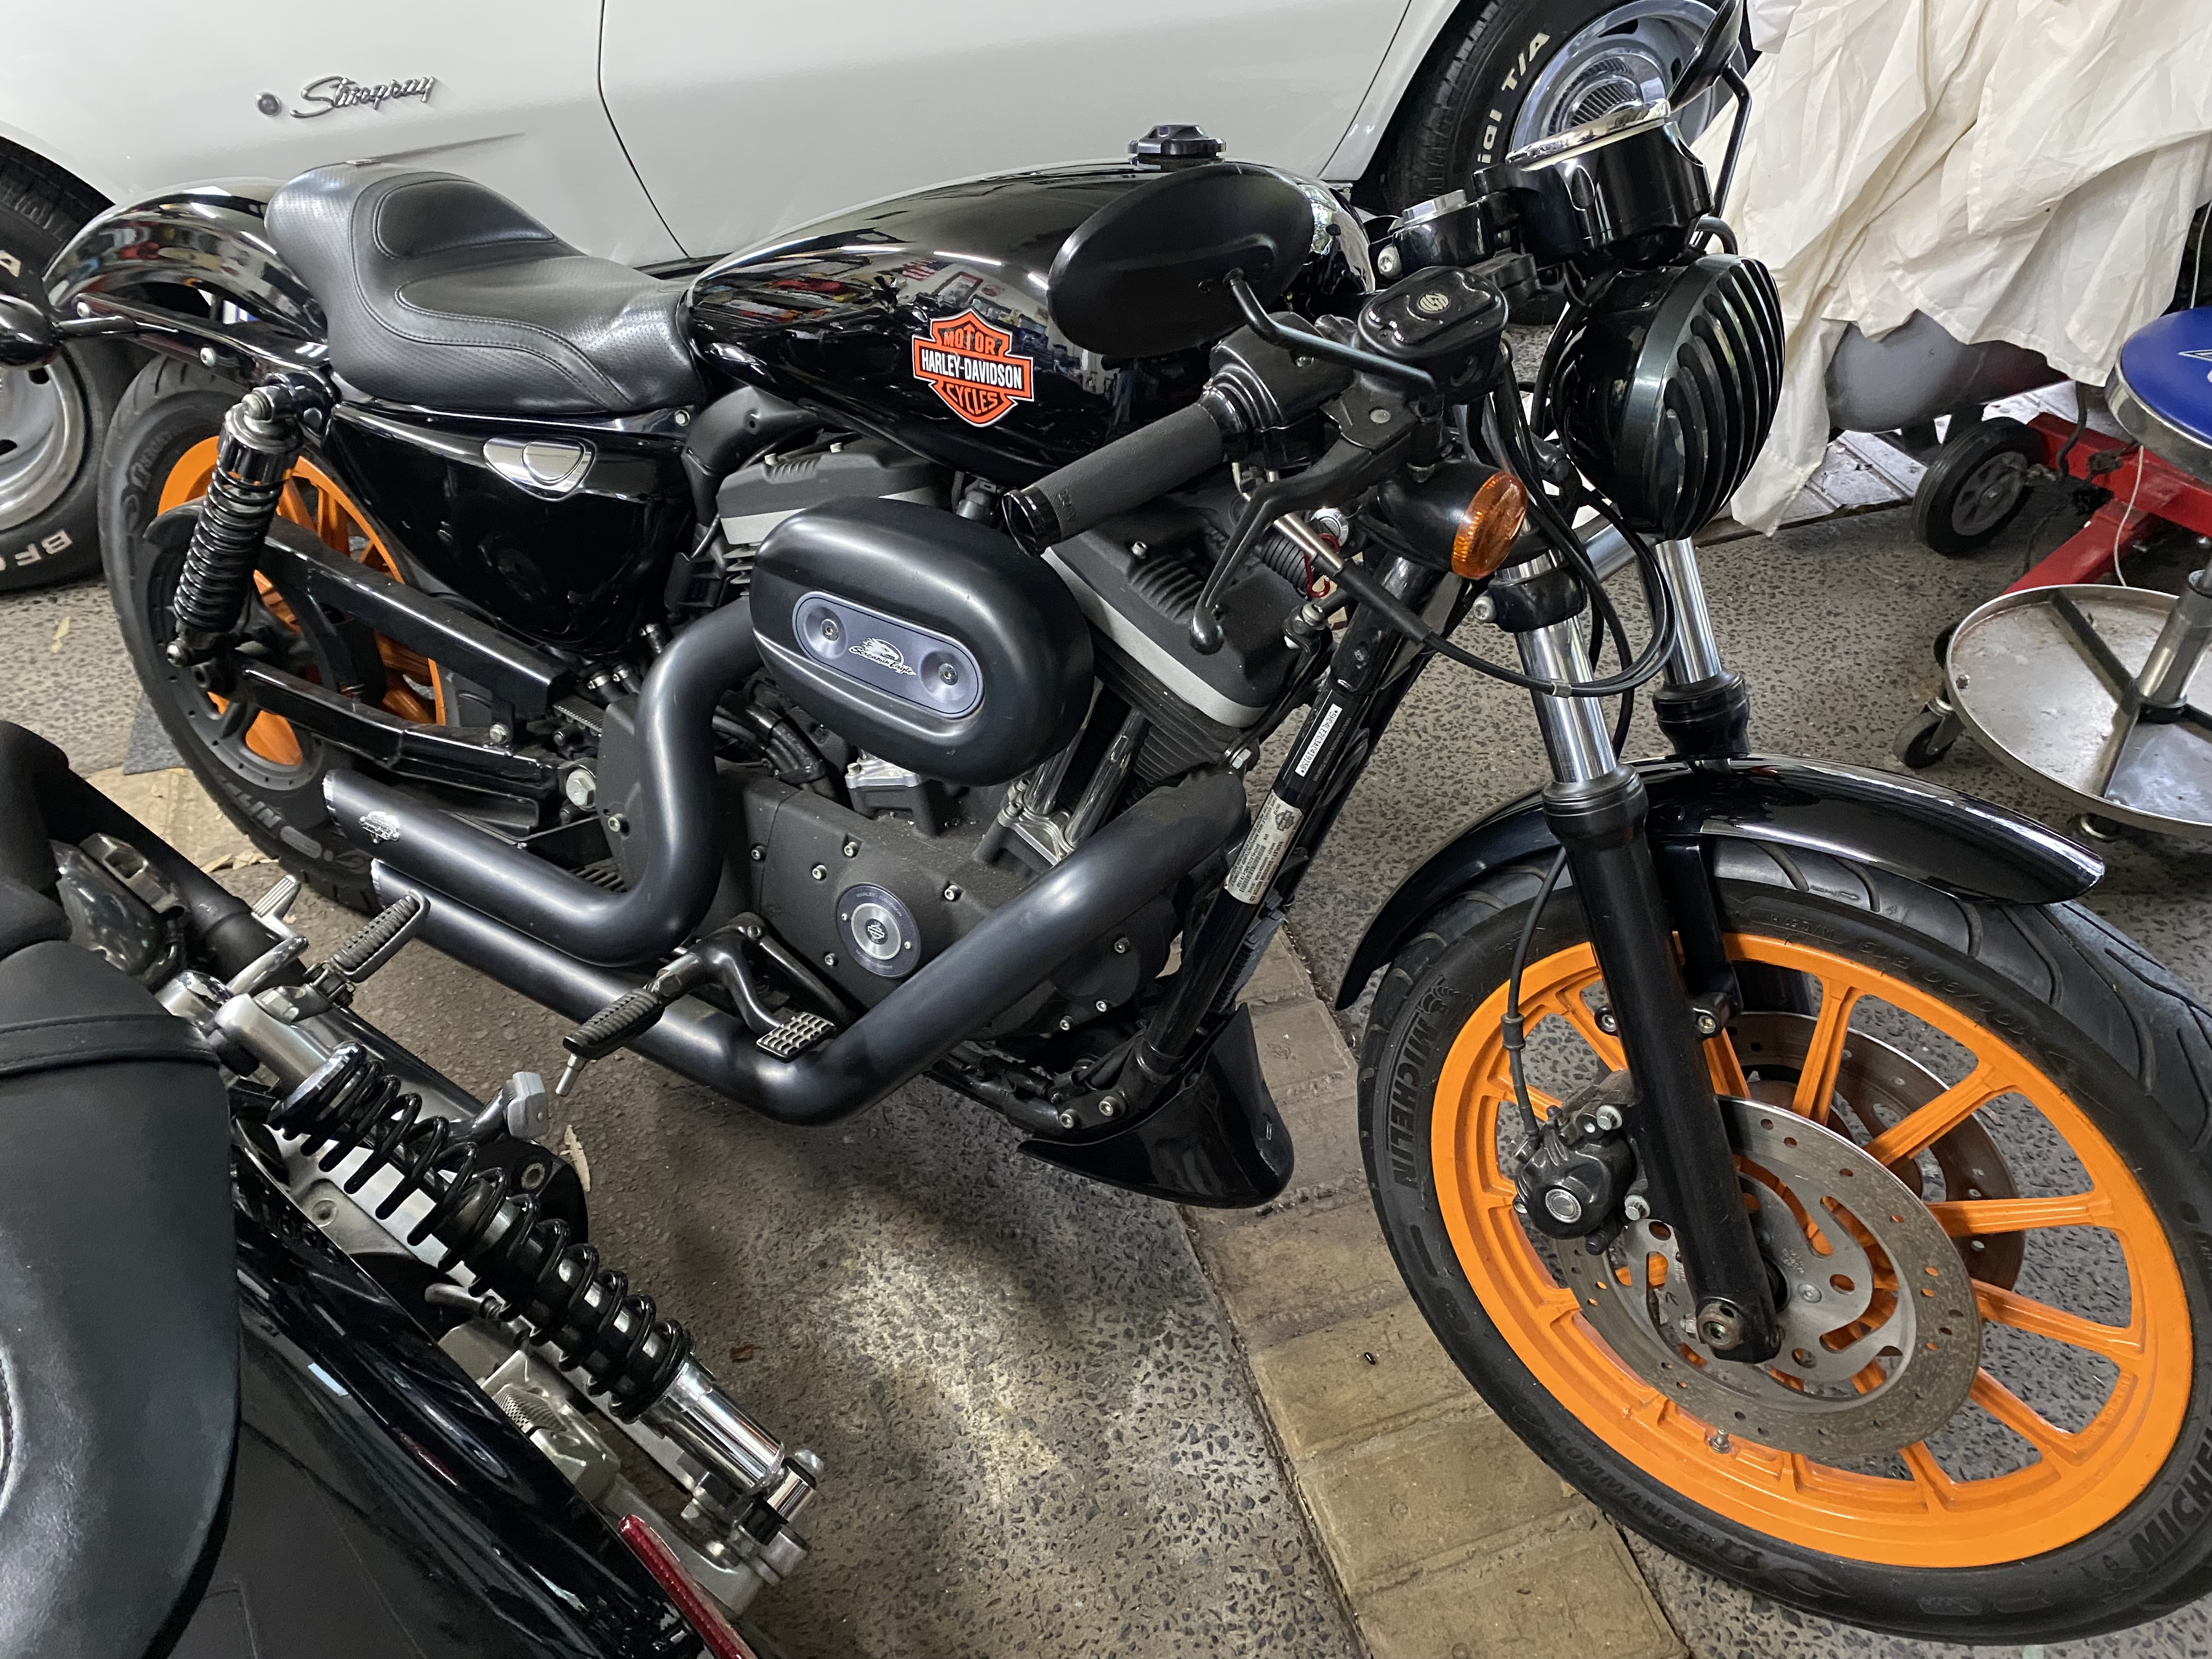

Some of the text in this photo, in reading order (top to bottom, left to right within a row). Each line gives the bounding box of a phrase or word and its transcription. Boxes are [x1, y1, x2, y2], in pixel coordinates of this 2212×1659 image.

[290, 76, 434, 117] Stingray
[1477, 32, 1550, 163] ial T/A
[944, 323, 996, 355] MOTOR
[922, 349, 1022, 390] HARLEY-DAVIDSON
[946, 384, 997, 415] CYCLES
[0, 529, 73, 571] BF
[890, 662, 913, 673] Eagle
[1252, 880, 1262, 895] MOTOR
[1389, 1013, 1437, 1188] MICHELIN
